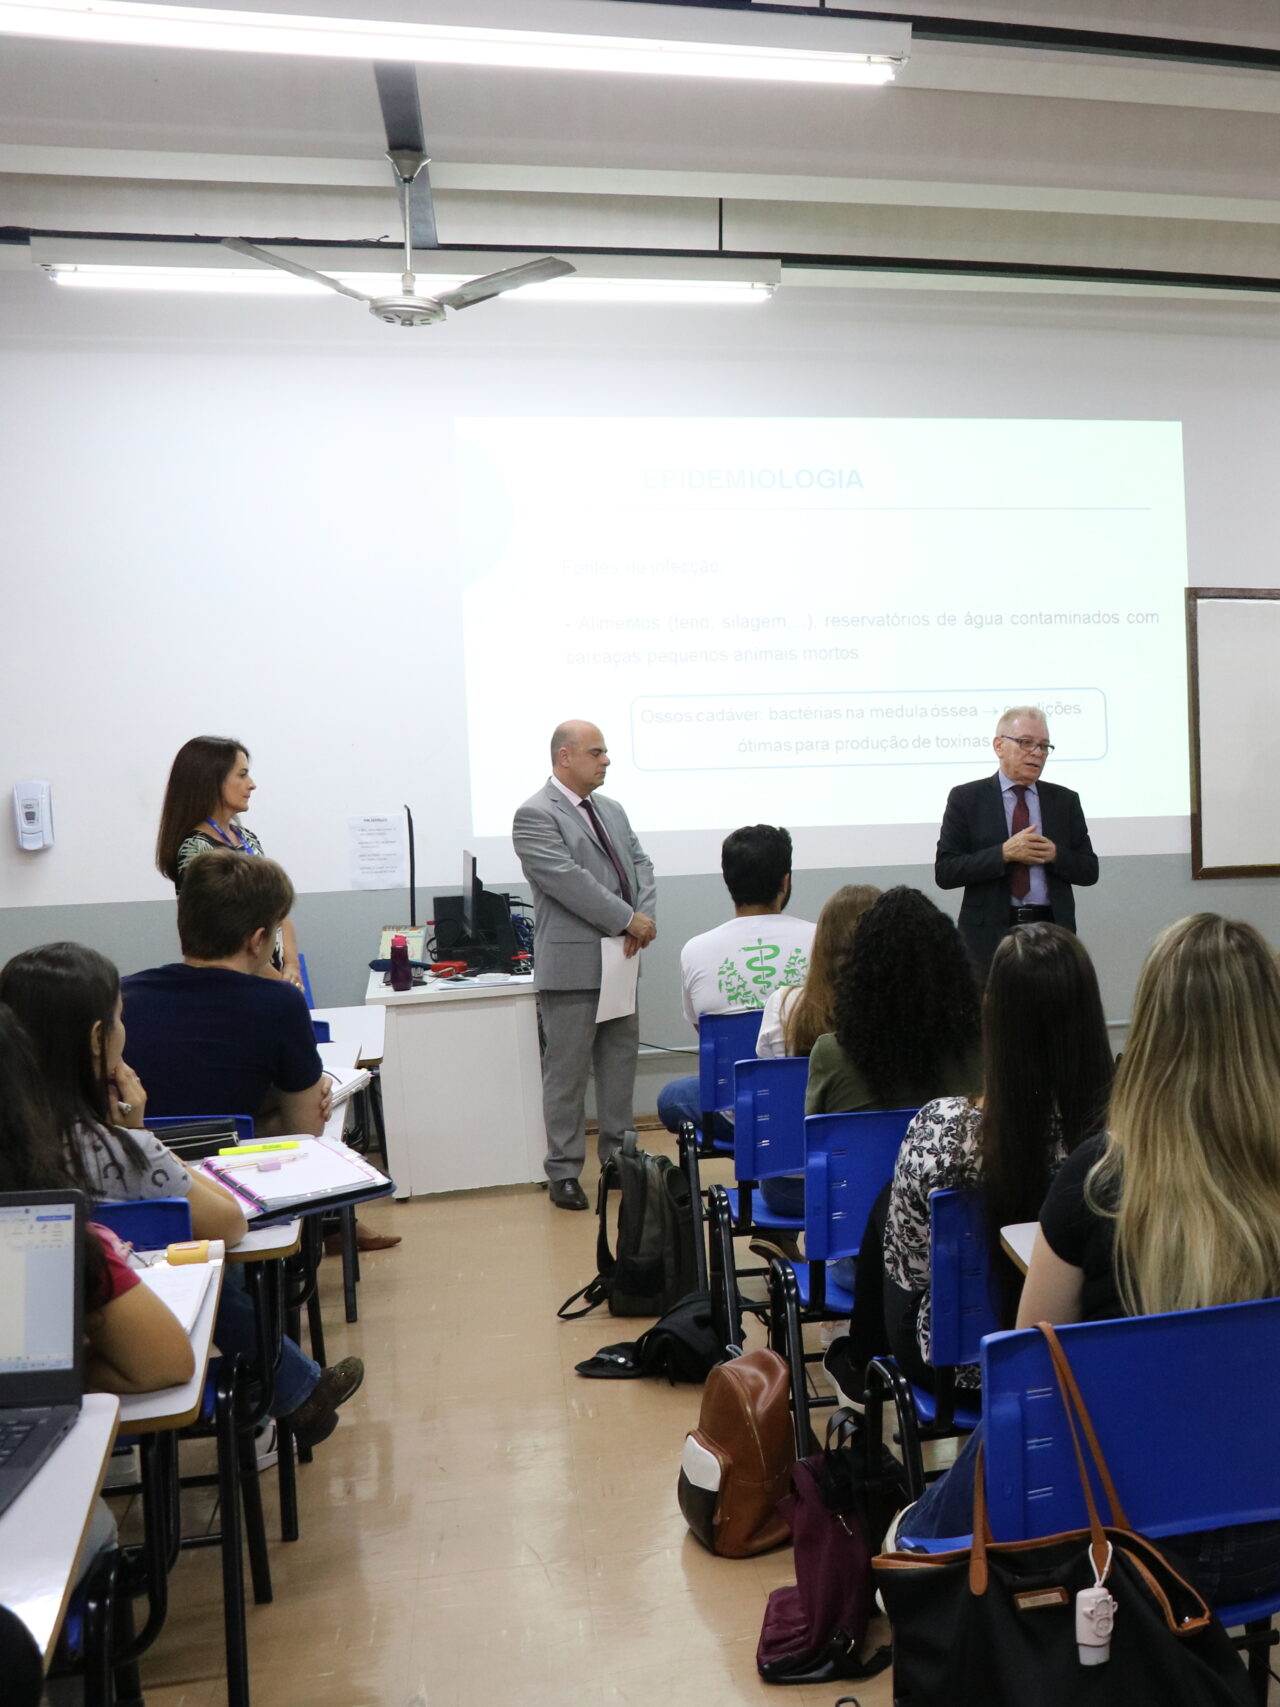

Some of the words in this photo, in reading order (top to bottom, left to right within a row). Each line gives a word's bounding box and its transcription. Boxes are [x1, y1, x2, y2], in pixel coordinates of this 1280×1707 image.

[642, 469, 865, 489] EPIDEMIOLOGIA
[625, 559, 645, 575] de
[577, 614, 661, 631] Alimentos
[825, 611, 930, 627] reservatórios
[936, 612, 957, 626] de
[963, 611, 1004, 629] água
[1010, 610, 1120, 626] contaminados
[1126, 613, 1160, 625] com
[565, 650, 641, 668] carcaças
[647, 649, 729, 667] pequenos
[734, 646, 798, 662] animais
[803, 646, 859, 661] mortos
[640, 709, 693, 725] Ossos
[769, 706, 842, 721] bactérias
[846, 708, 864, 719] na
[870, 705, 928, 719] medula
[931, 704, 978, 718] óssea
[737, 738, 792, 754] ótimas
[795, 740, 830, 754] para
[835, 735, 909, 754] produção
[911, 736, 932, 750] de
[935, 735, 991, 749] toxinas
